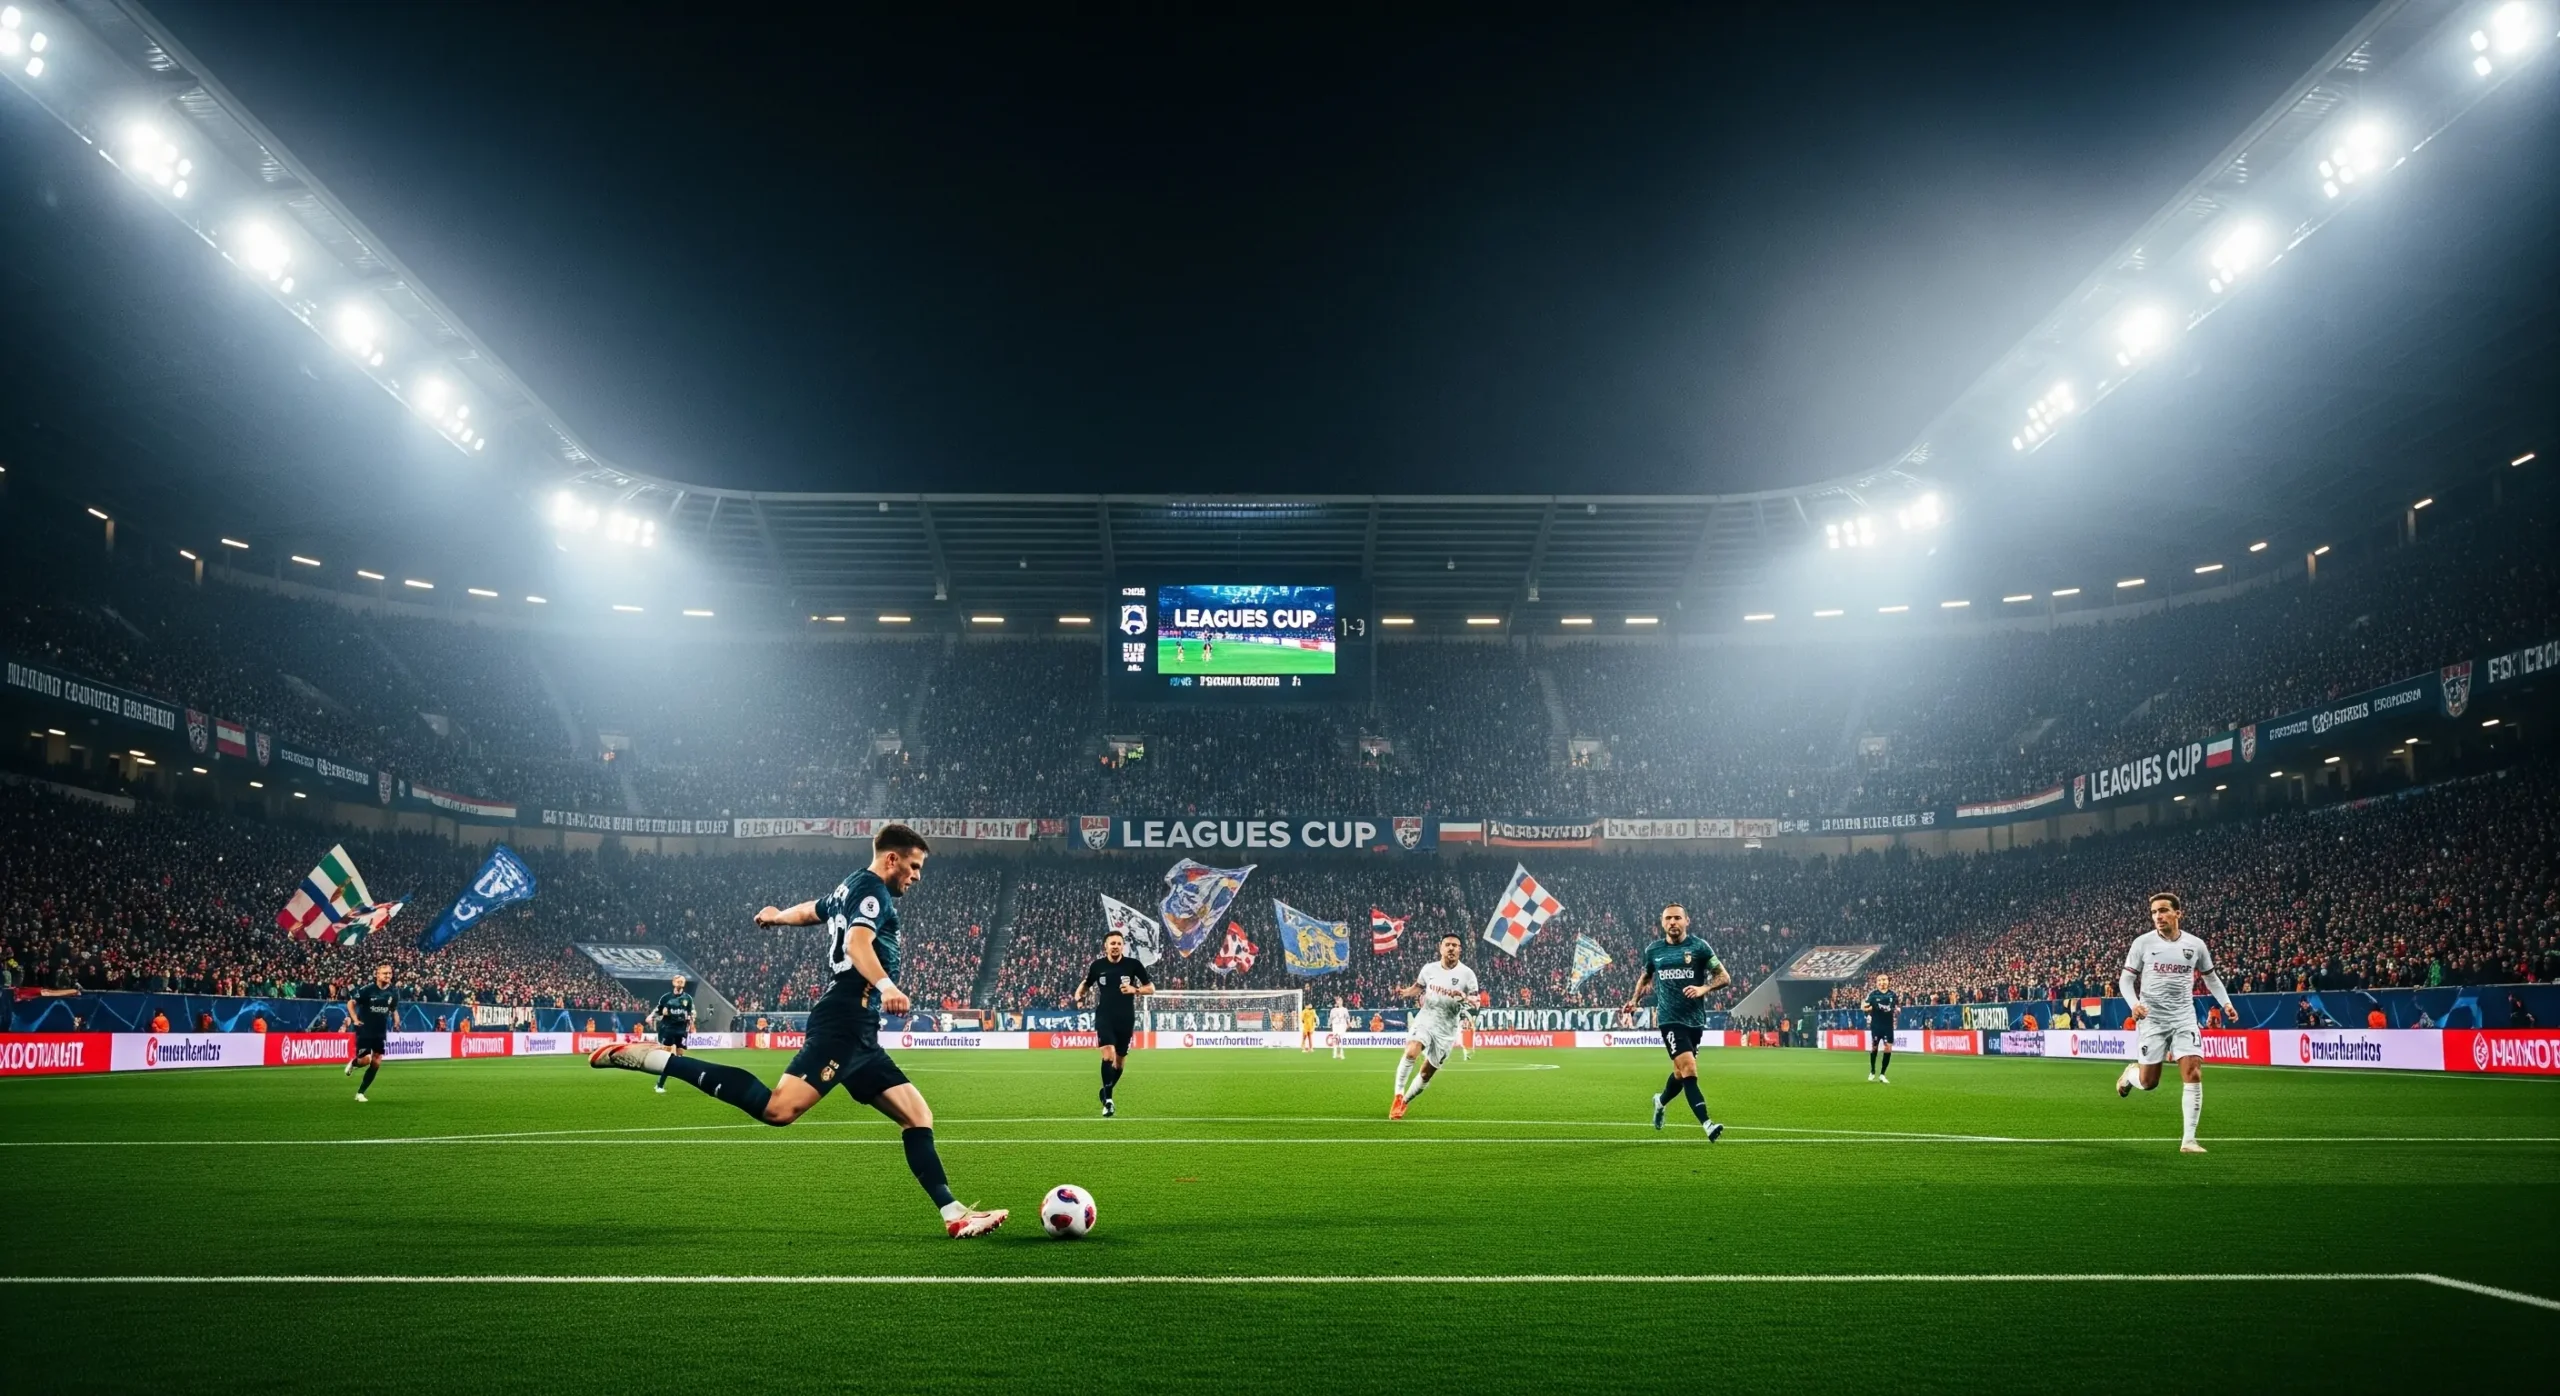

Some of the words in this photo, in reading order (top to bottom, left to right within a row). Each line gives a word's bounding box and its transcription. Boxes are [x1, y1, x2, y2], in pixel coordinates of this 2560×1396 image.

[1174, 608, 1269, 629] LEAGUES
[1272, 609, 1317, 629] CUP
[2091, 754, 2162, 801] LEAGUES
[2166, 742, 2202, 781] CUP
[1122, 820, 1292, 849] LEAGUES
[1301, 821, 1377, 849] CUP
